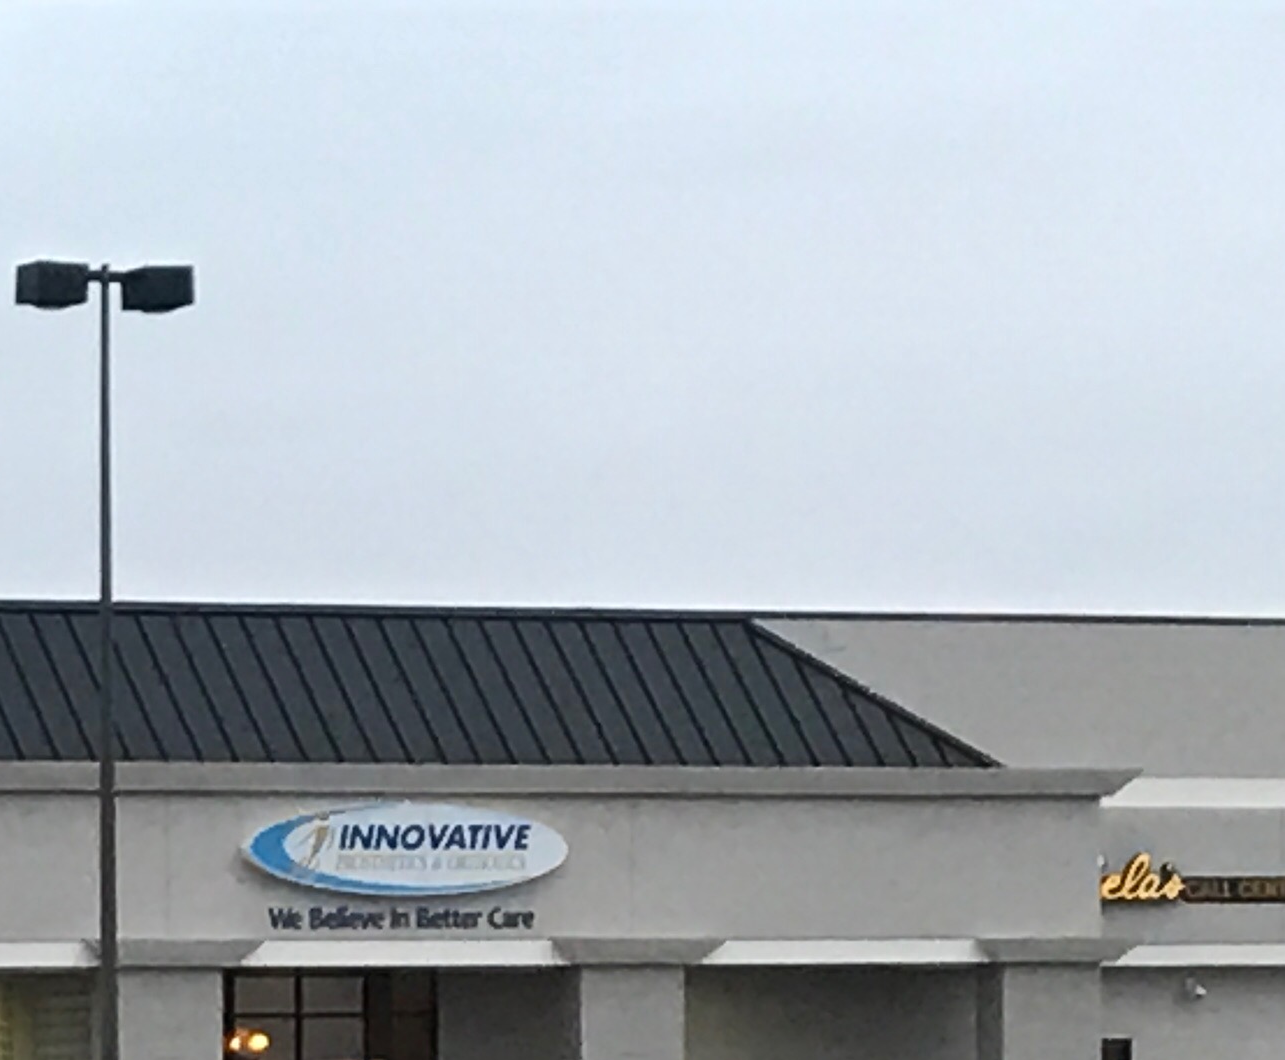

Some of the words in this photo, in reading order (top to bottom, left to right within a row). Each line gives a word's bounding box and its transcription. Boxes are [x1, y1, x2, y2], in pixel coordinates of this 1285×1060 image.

[339, 824, 531, 850] INNOVATIVE
[268, 907, 302, 930] We
[308, 906, 384, 930] Believe
[389, 906, 411, 929] In
[416, 906, 482, 930] Better
[486, 906, 535, 930] Care
